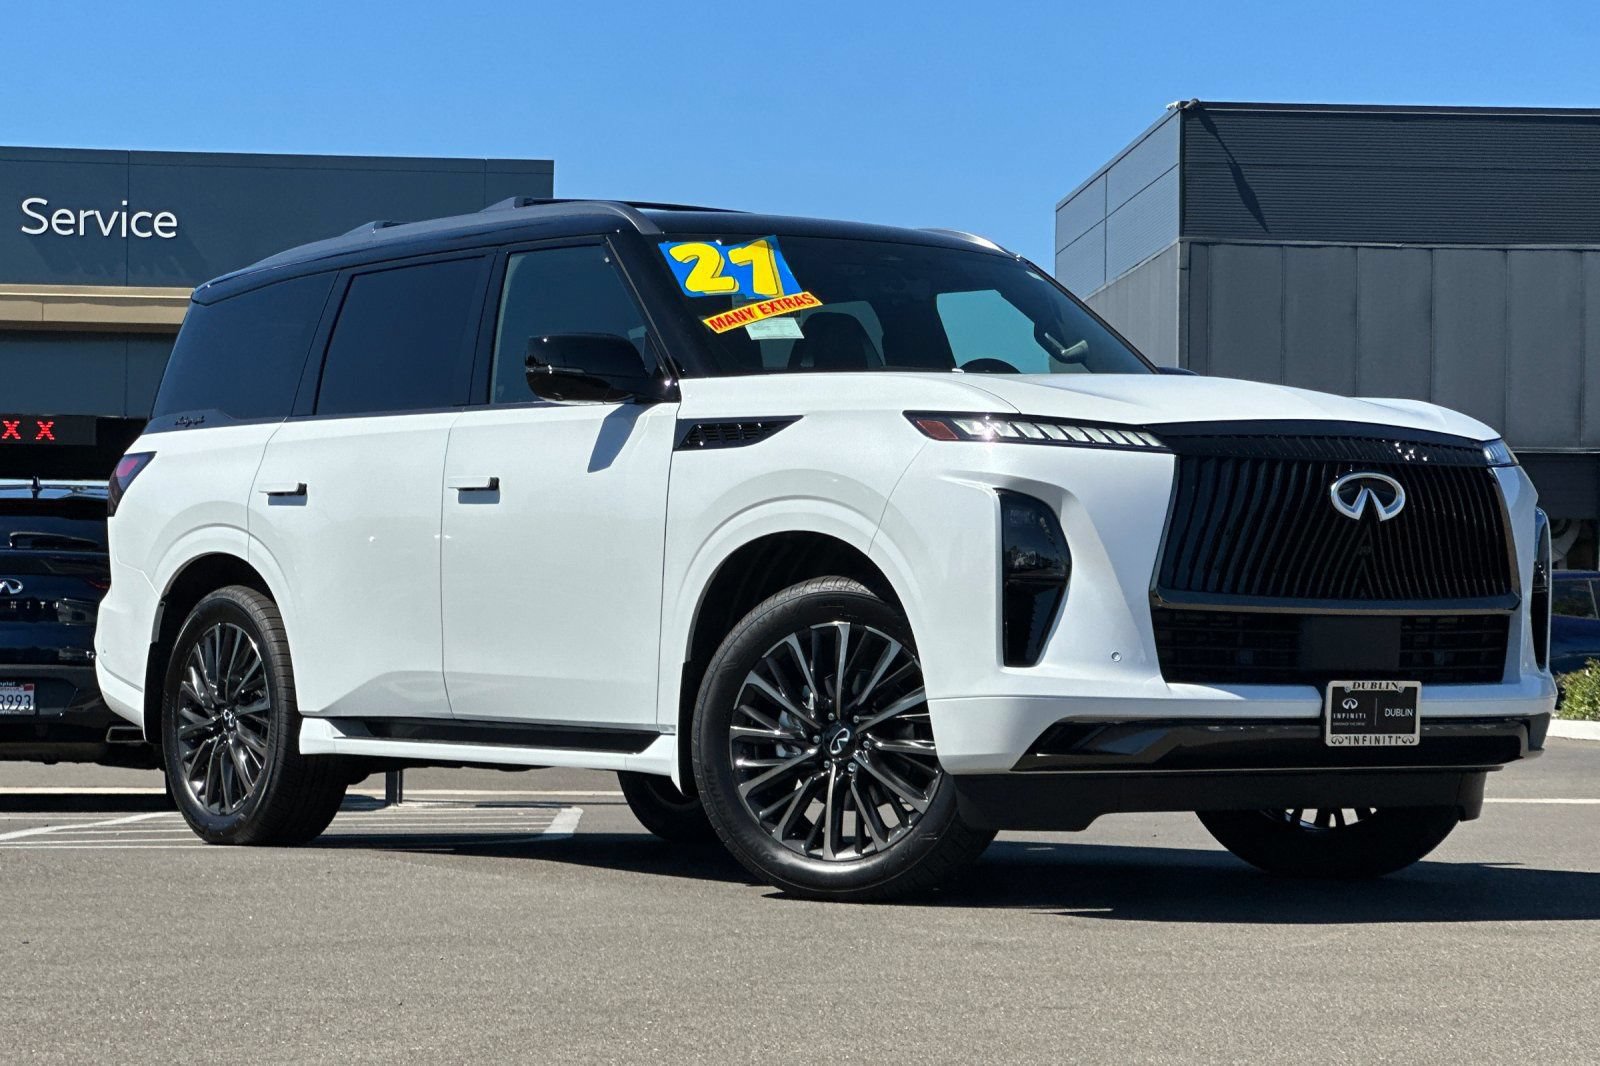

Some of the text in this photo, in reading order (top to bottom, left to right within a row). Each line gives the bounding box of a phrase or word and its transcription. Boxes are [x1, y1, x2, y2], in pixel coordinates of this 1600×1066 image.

[21, 197, 178, 238] Service
[708, 293, 816, 332] MANY EXTRAS
[1352, 681, 1399, 690] DUBLIN
[1384, 708, 1413, 718] DUBLIN
[1348, 735, 1398, 745] INFINITI
